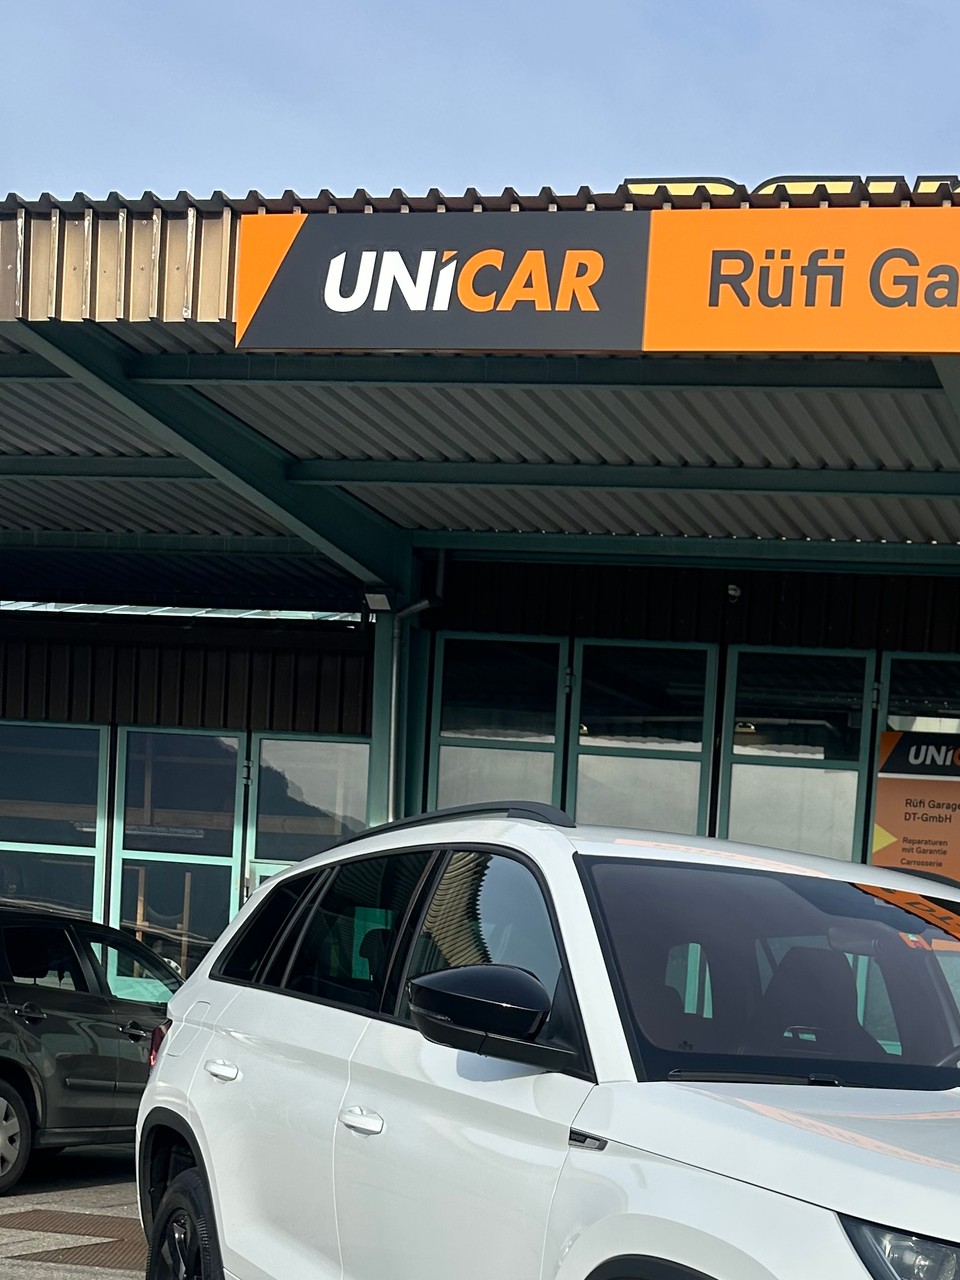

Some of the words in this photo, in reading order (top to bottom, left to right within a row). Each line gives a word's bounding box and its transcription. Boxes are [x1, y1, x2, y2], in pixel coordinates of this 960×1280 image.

[707, 248, 846, 308] Rüfi
[905, 798, 926, 808] Rüfi
[904, 812, 952, 823] DT-GmbH
[902, 836, 948, 846] Reparaturen
[915, 847, 948, 855] Garantie
[900, 857, 943, 867] Carrosserie
